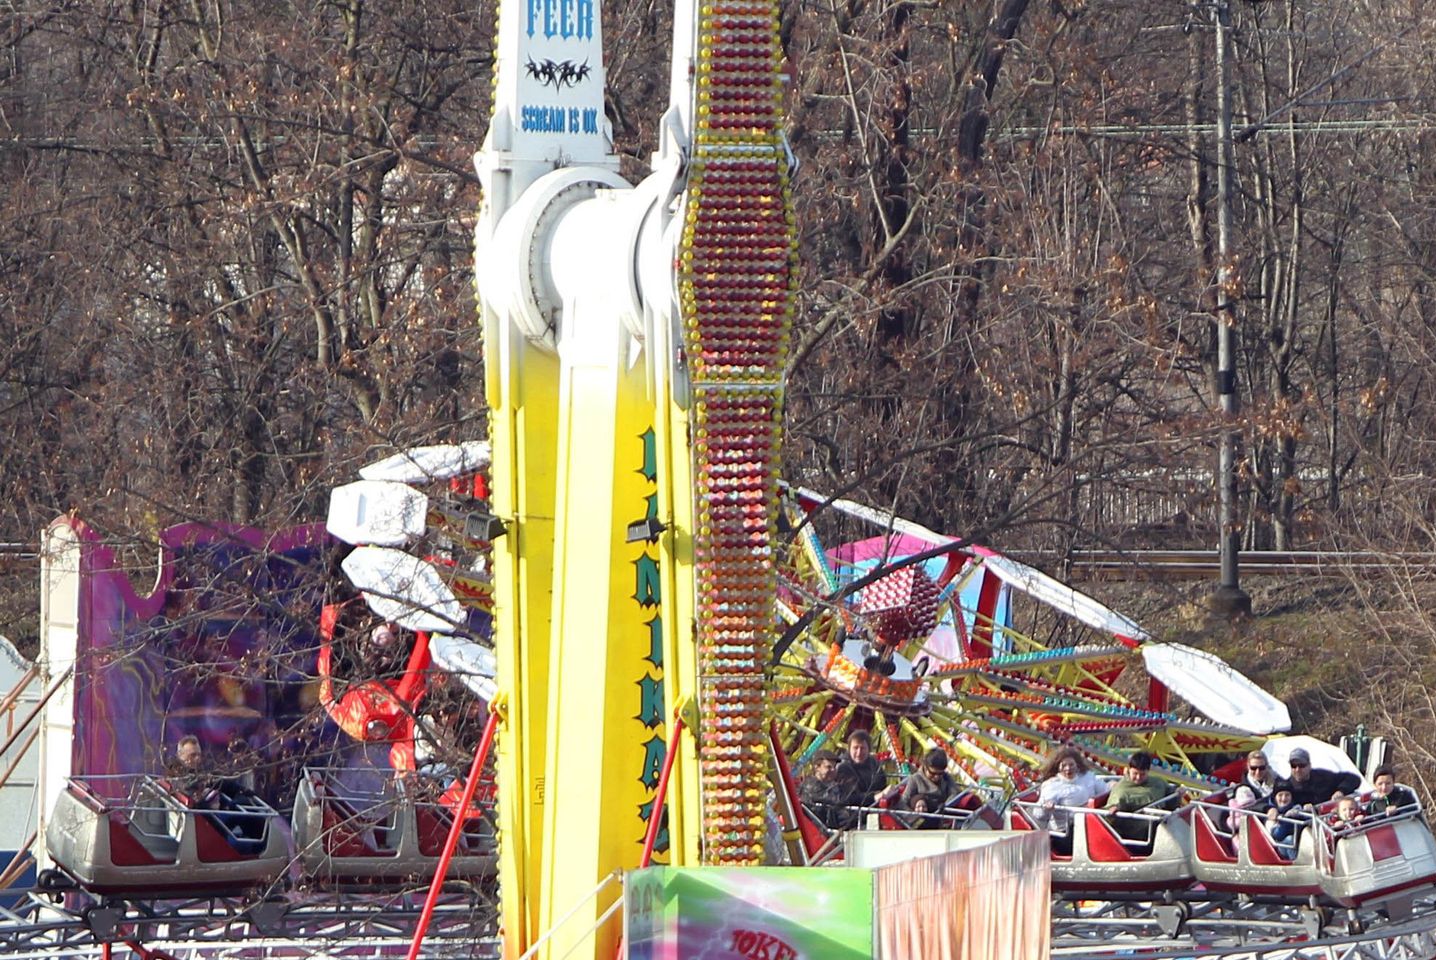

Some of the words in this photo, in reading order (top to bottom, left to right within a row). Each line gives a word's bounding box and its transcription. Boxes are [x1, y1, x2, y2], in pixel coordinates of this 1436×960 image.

[527, 0, 593, 41] FEER
[521, 105, 565, 133] SCREAM
[568, 107, 580, 134] IS
